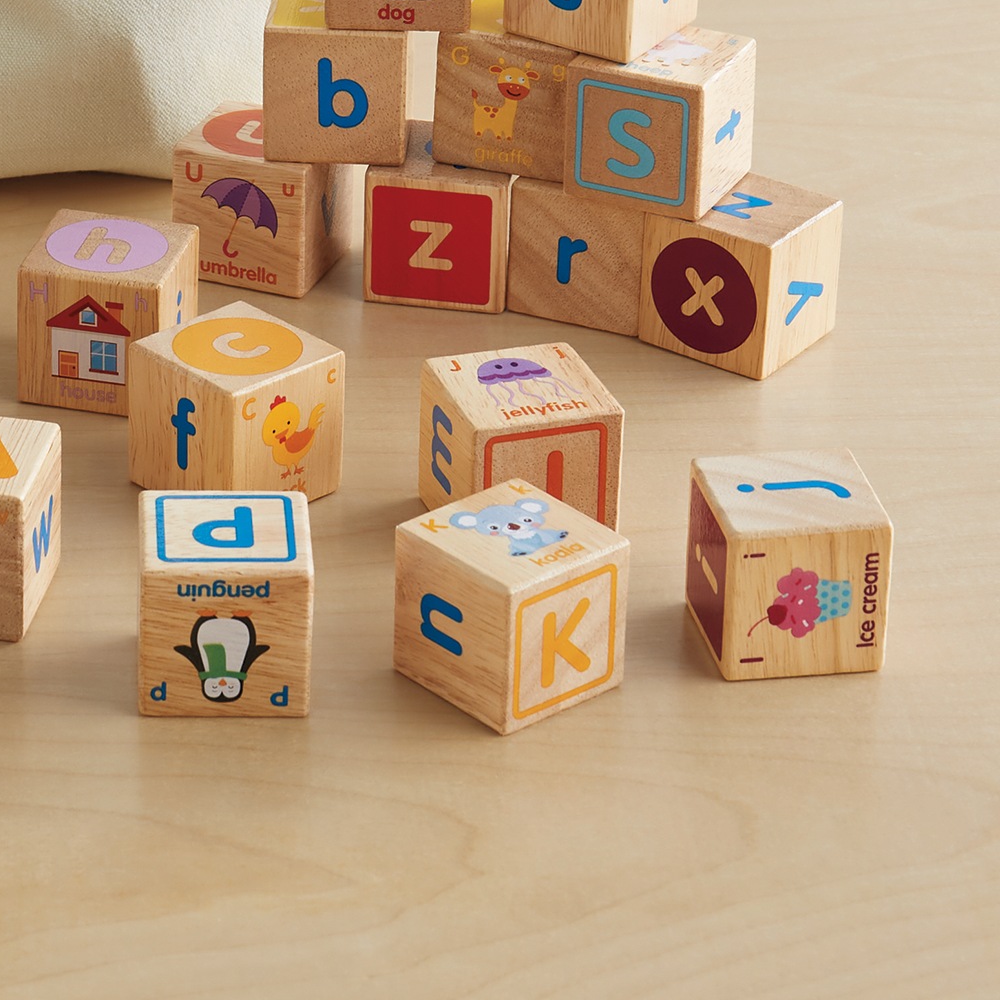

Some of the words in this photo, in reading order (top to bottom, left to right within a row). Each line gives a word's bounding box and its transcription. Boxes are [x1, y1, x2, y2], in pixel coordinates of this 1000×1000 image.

[377, 3, 415, 24] dog
[451, 46, 470, 66] G
[317, 57, 369, 129] b
[474, 147, 534, 168] giraffe
[185, 161, 203, 183] U
[282, 183, 295, 198] u
[73, 226, 132, 266] h
[556, 235, 588, 285] r
[200, 260, 278, 286] umbrella
[29, 281, 48, 303] H
[134, 291, 148, 312] h
[59, 382, 117, 403] house
[500, 399, 588, 421] jellyfish
[170, 397, 196, 471] f
[529, 541, 585, 567] koala
[177, 579, 271, 602] penguin
[861, 552, 880, 613] cream
[540, 597, 591, 688] K
